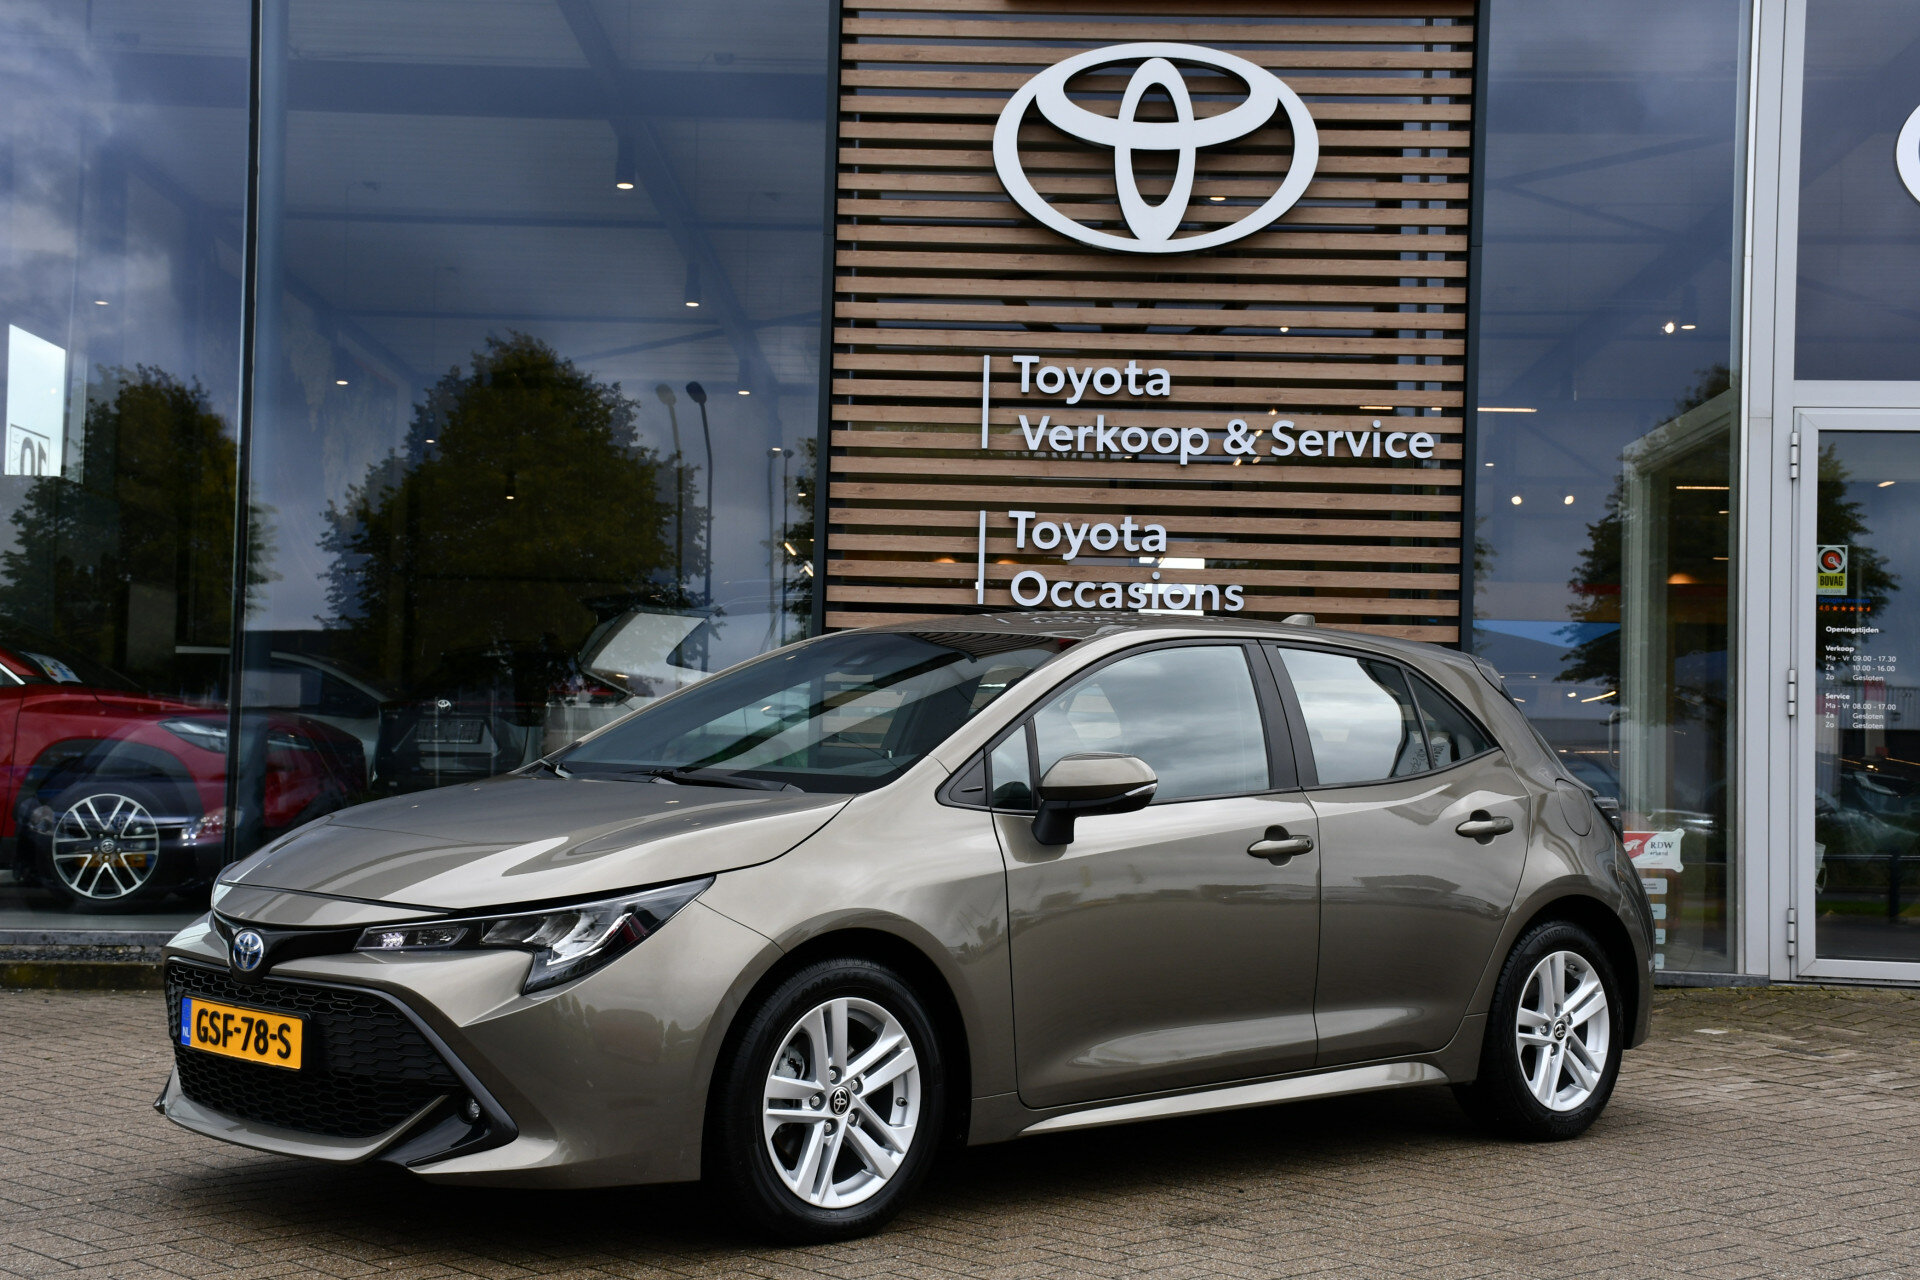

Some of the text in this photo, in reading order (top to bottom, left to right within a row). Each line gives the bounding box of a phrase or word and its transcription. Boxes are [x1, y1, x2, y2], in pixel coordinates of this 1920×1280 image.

[1012, 355, 1170, 404] Toyota
[1018, 414, 1435, 466] Verkoop & Service
[1008, 510, 1167, 561] Toyota
[1820, 575, 1843, 587] BOVAG
[1010, 570, 1245, 612] Occasions
[1825, 626, 1879, 635] Openingstijden
[1825, 645, 1855, 653] Verkoop
[1852, 674, 1884, 682] Gesloten
[1852, 722, 1884, 730] Gesloten
[1650, 841, 1674, 849] RDW
[182, 1007, 292, 1060] NL GSF-78-S
